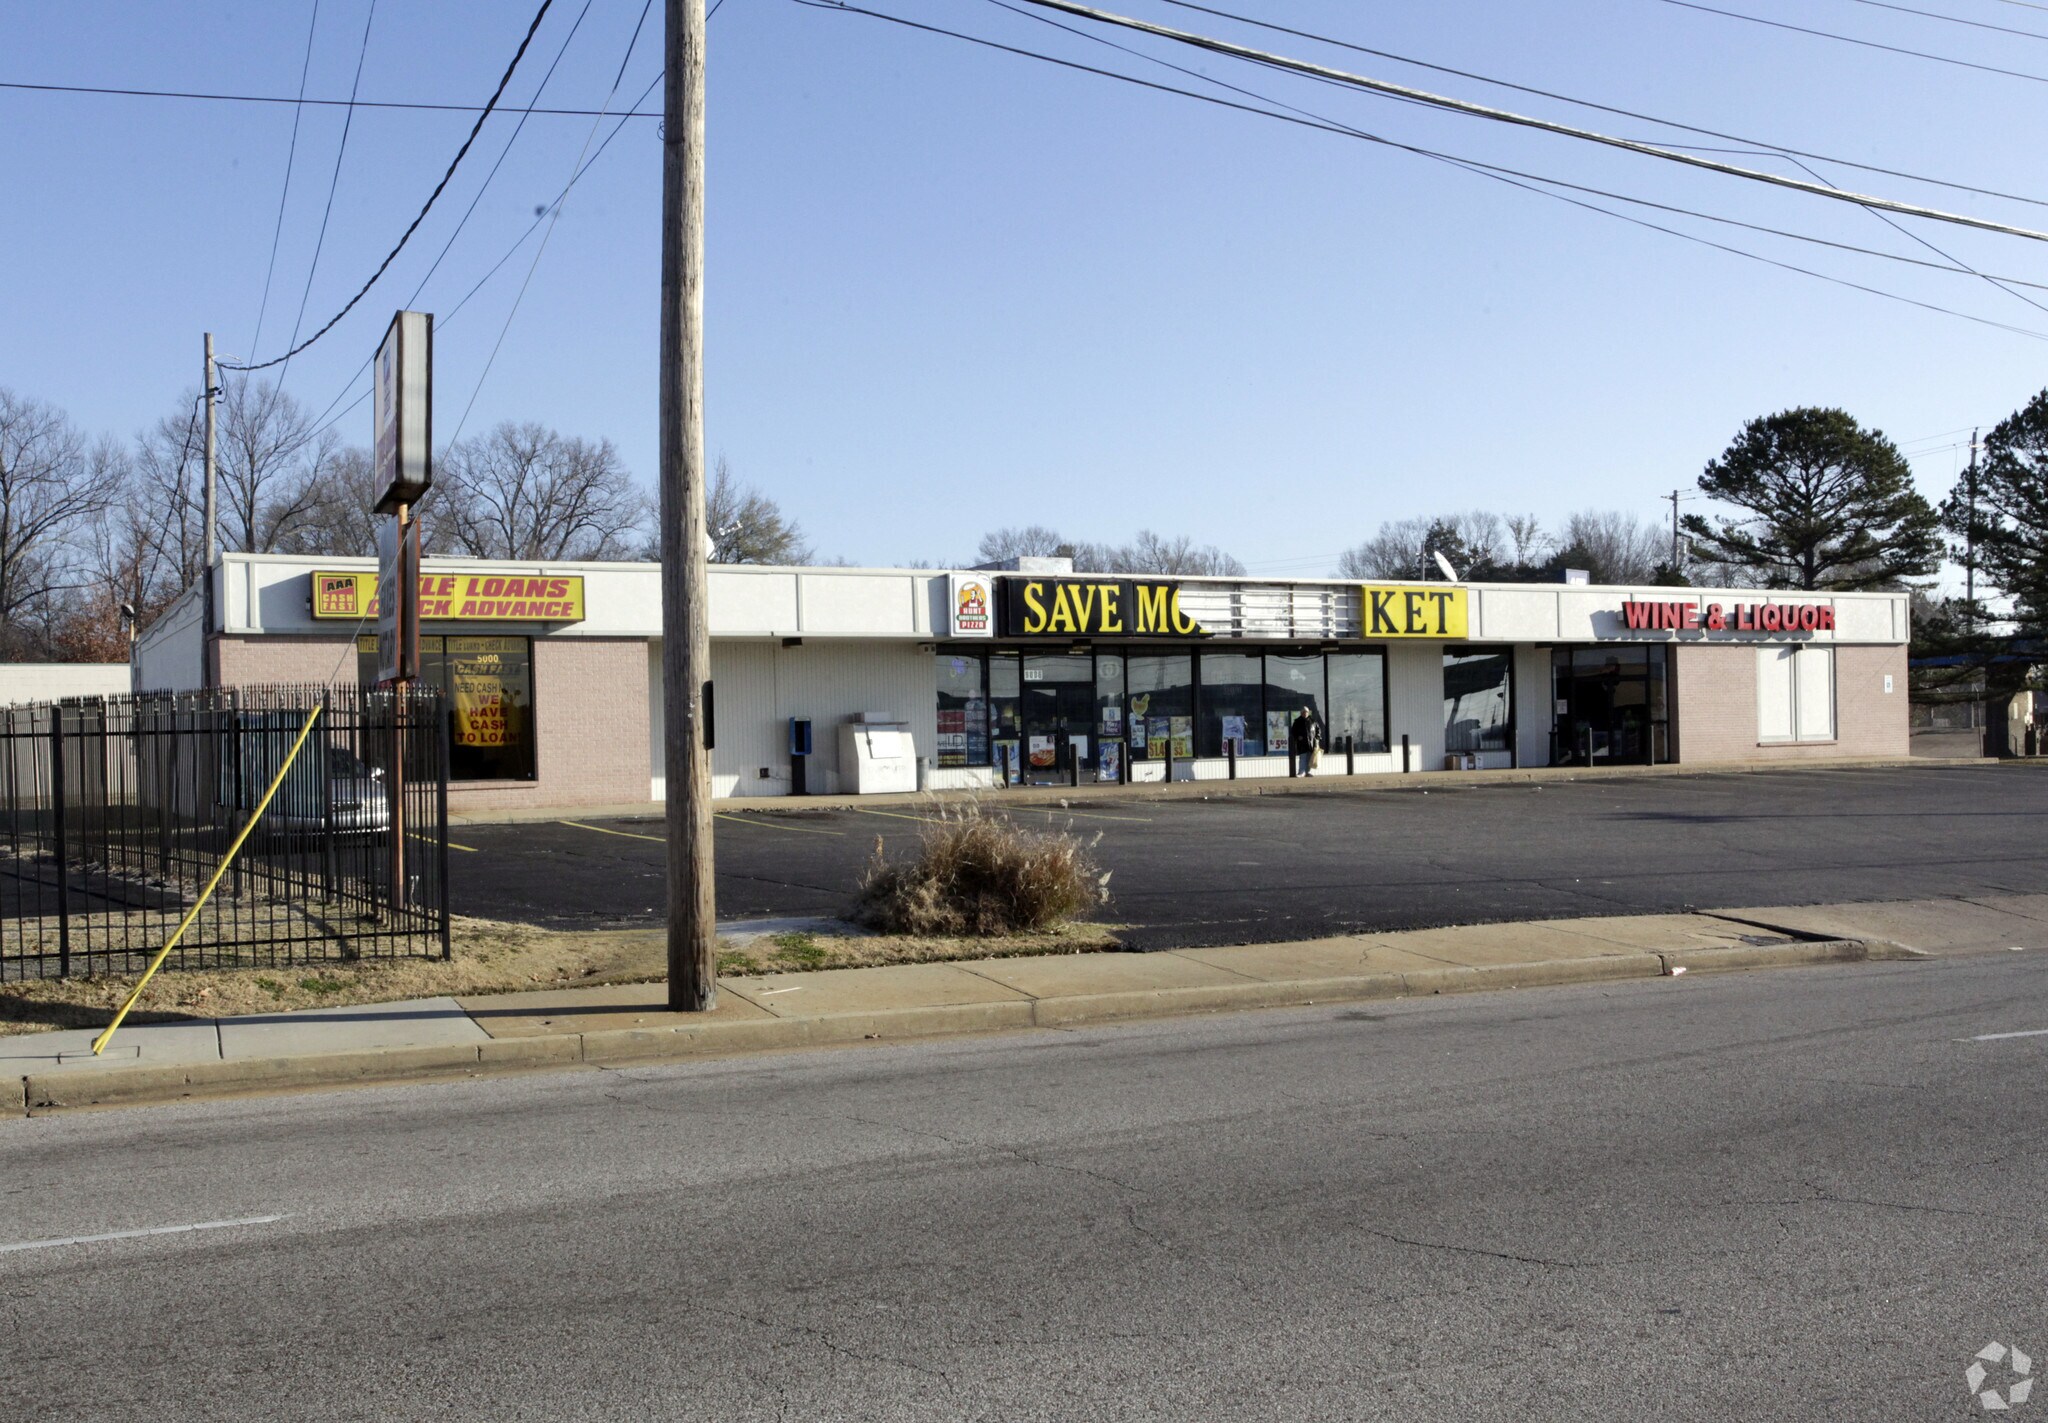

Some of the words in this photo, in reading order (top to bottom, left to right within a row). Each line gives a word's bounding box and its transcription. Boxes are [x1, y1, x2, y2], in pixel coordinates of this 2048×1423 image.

[326, 579, 353, 592] AAA
[465, 578, 570, 598] LOANS
[322, 594, 353, 602] CASH
[322, 602, 353, 611] FAST
[367, 599, 453, 615] CCK
[459, 601, 574, 617] ADVANCE
[1024, 583, 1123, 633] SAVE
[1136, 585, 1209, 634] MO
[1369, 591, 1454, 634] KET
[1622, 602, 1699, 629] WINE
[1706, 603, 1727, 630] &
[1734, 603, 1835, 631] LIQUOR
[962, 621, 984, 629] PIZZA
[359, 637, 376, 651] TITLE
[447, 638, 463, 651] TITLE
[477, 654, 499, 663] 5000
[456, 664, 488, 675] CASH
[455, 683, 474, 693] NEED
[476, 683, 498, 693] CASH
[478, 695, 499, 704] WE
[470, 707, 508, 717] HAVE
[470, 720, 508, 730] CASH
[457, 733, 476, 743] TO
